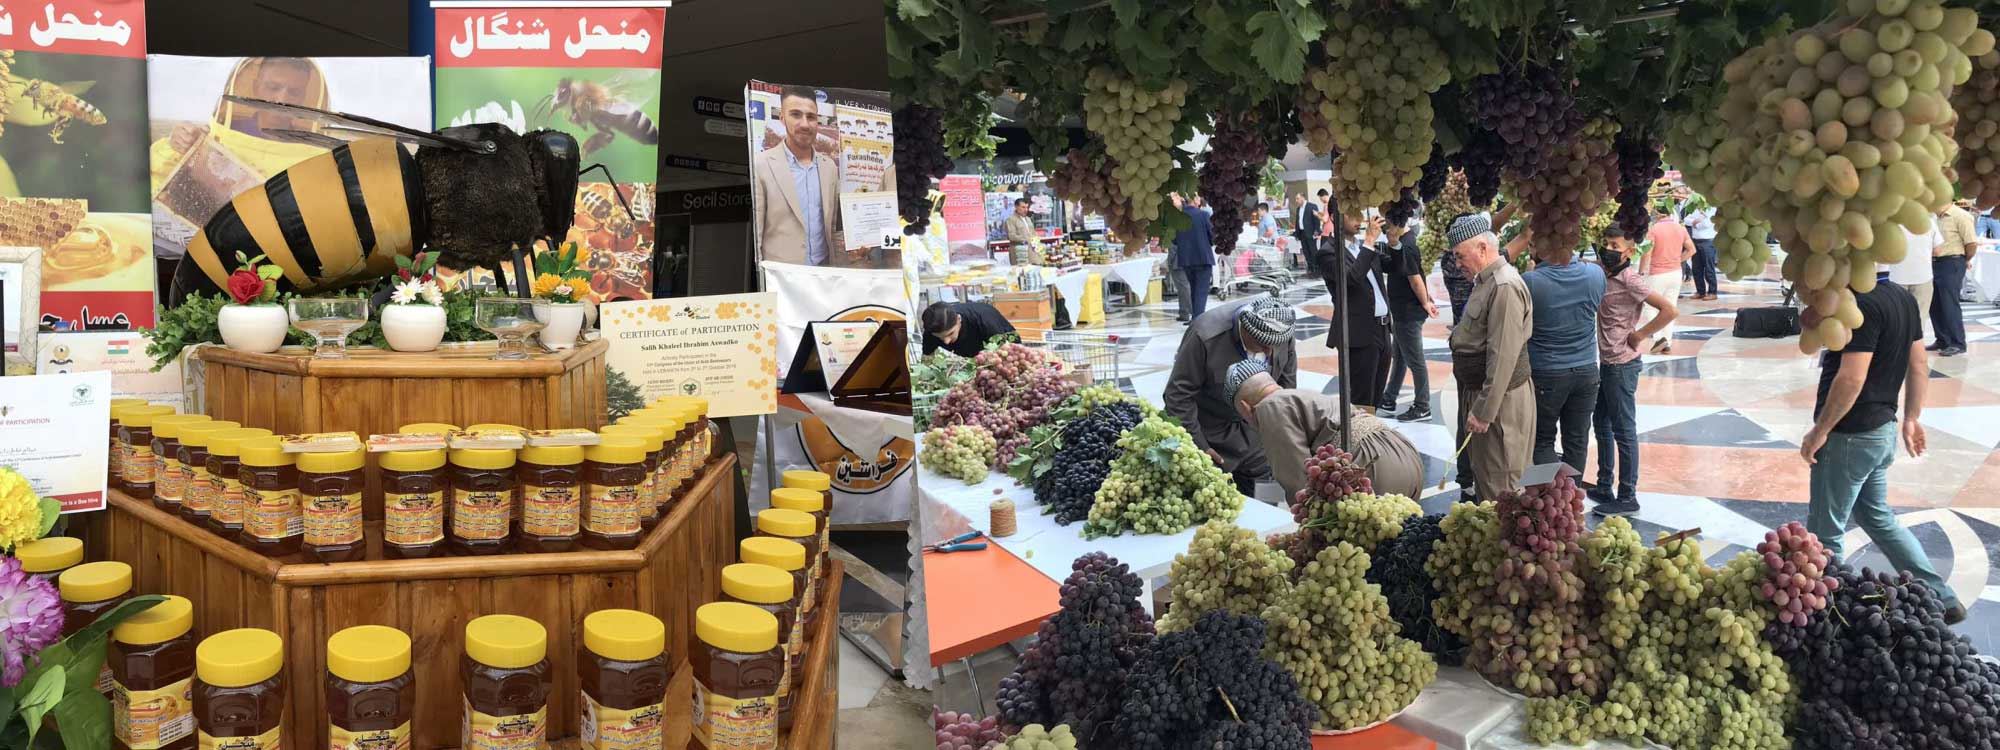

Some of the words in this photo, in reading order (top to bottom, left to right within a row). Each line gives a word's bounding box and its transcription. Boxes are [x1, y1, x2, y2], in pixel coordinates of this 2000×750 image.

[30, 3, 131, 47] منحل
[450, 12, 550, 58] شنگال
[564, 17, 651, 59] منحل
[619, 328, 678, 340] CERTIFICATE
[680, 327, 689, 336] of
[691, 323, 760, 335] PARTICIPATION
[658, 342, 682, 350] Khaleel
[683, 341, 709, 349] Ibrahim
[5, 417, 50, 426] PARTICIPATION
